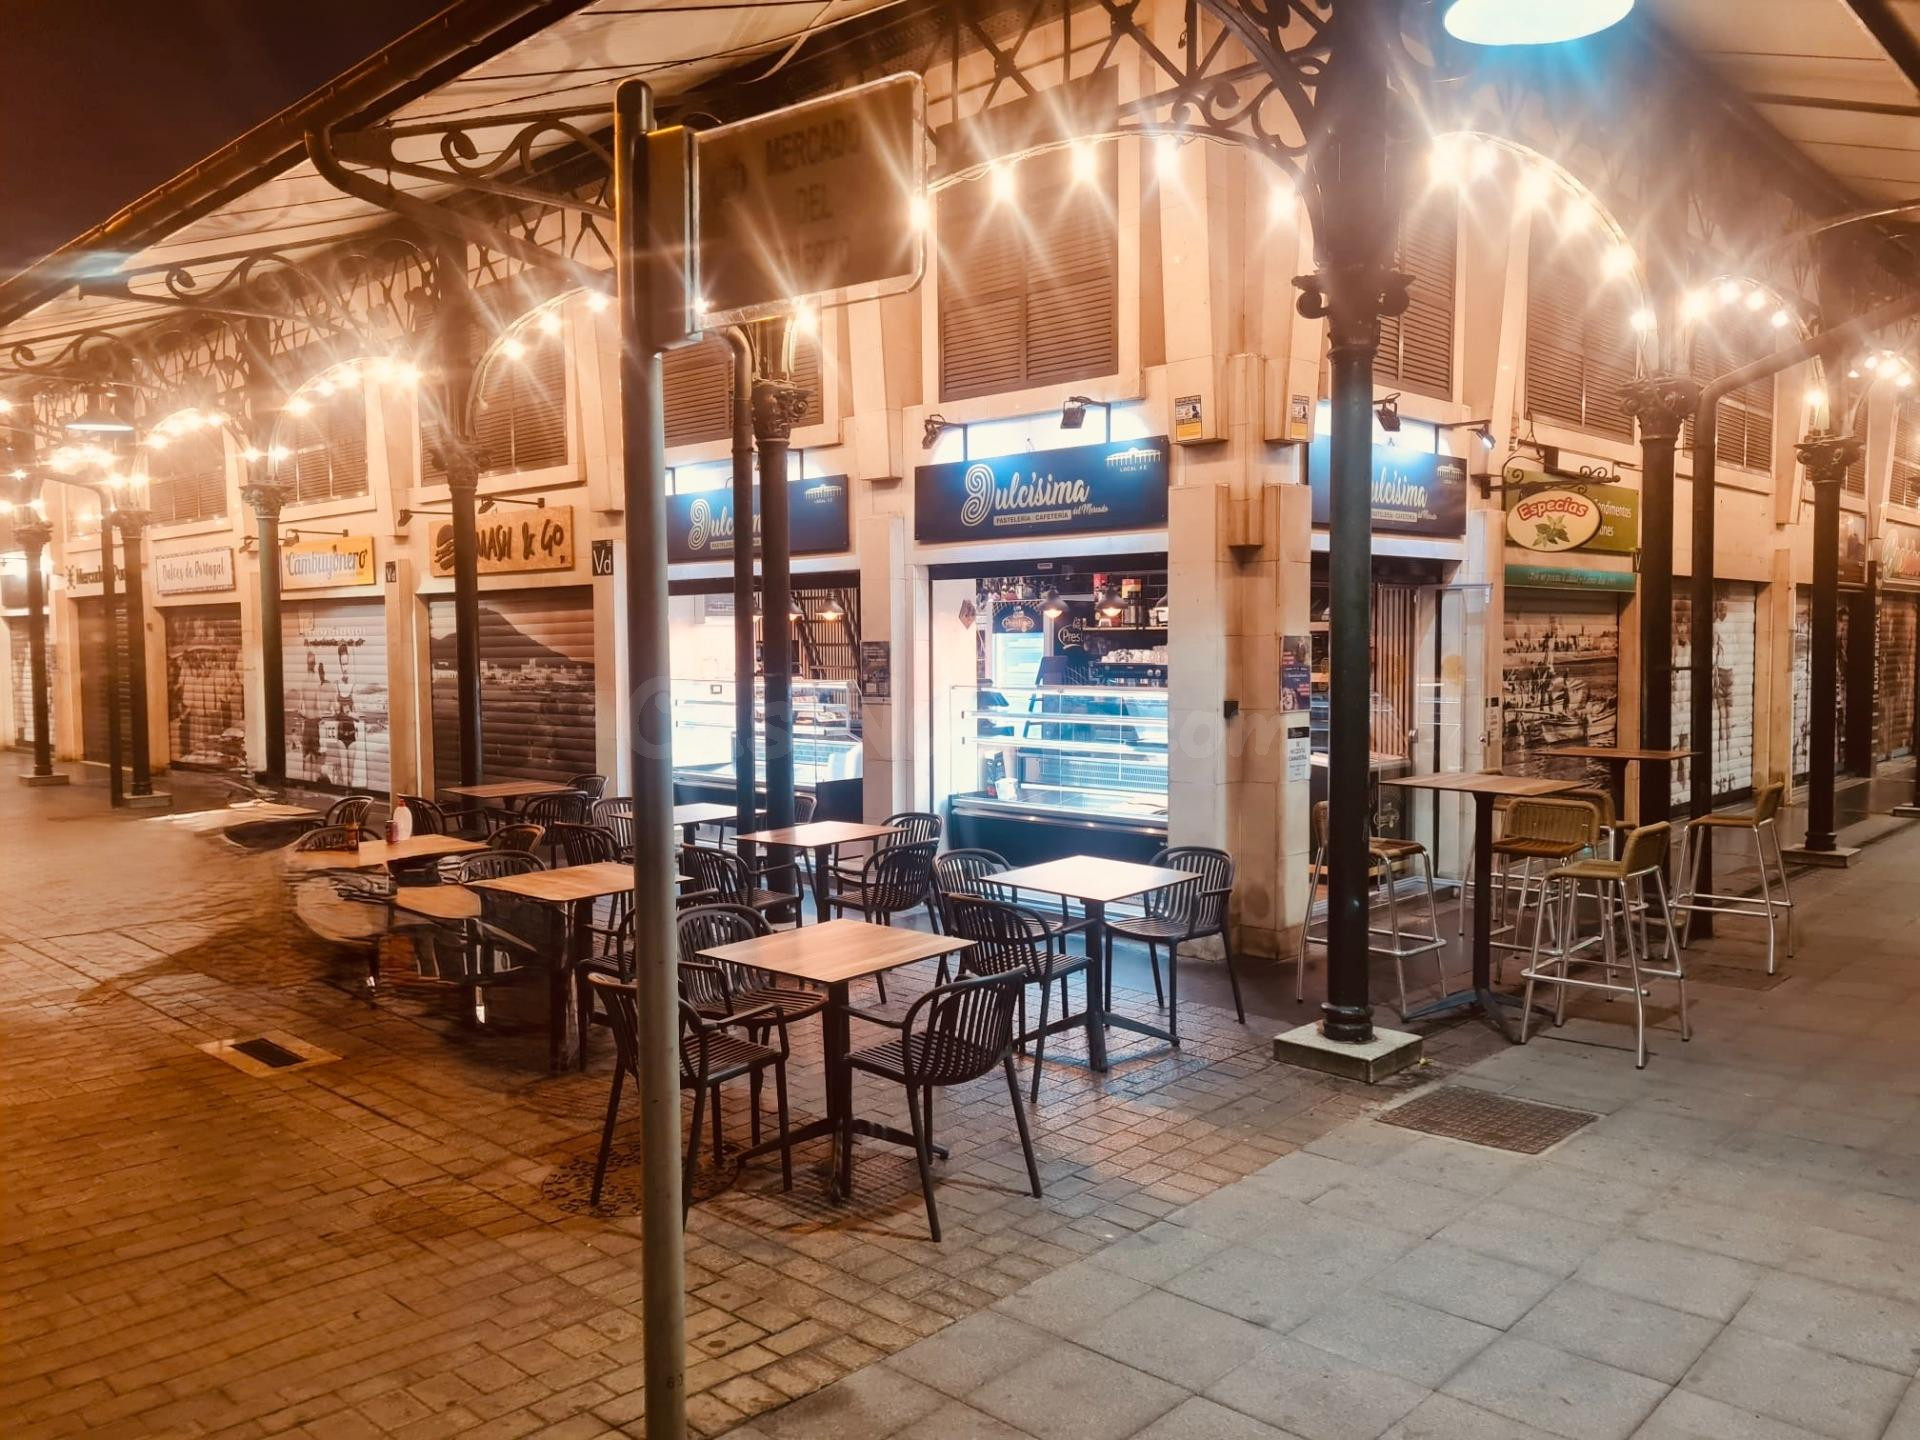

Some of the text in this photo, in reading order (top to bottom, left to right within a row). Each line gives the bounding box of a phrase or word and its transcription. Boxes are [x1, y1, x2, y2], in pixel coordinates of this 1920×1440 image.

[766, 114, 862, 176] MERCADO
[796, 183, 834, 224] DEL
[1371, 466, 1428, 508] ulcísima
[1517, 497, 1589, 521] Especias
[1595, 498, 1632, 518] ondimentos
[475, 518, 565, 562] MASH & GO
[185, 561, 193, 578] de
[194, 557, 225, 581] Portugal
[593, 549, 611, 574] Vd
[76, 565, 103, 585] Mercad
